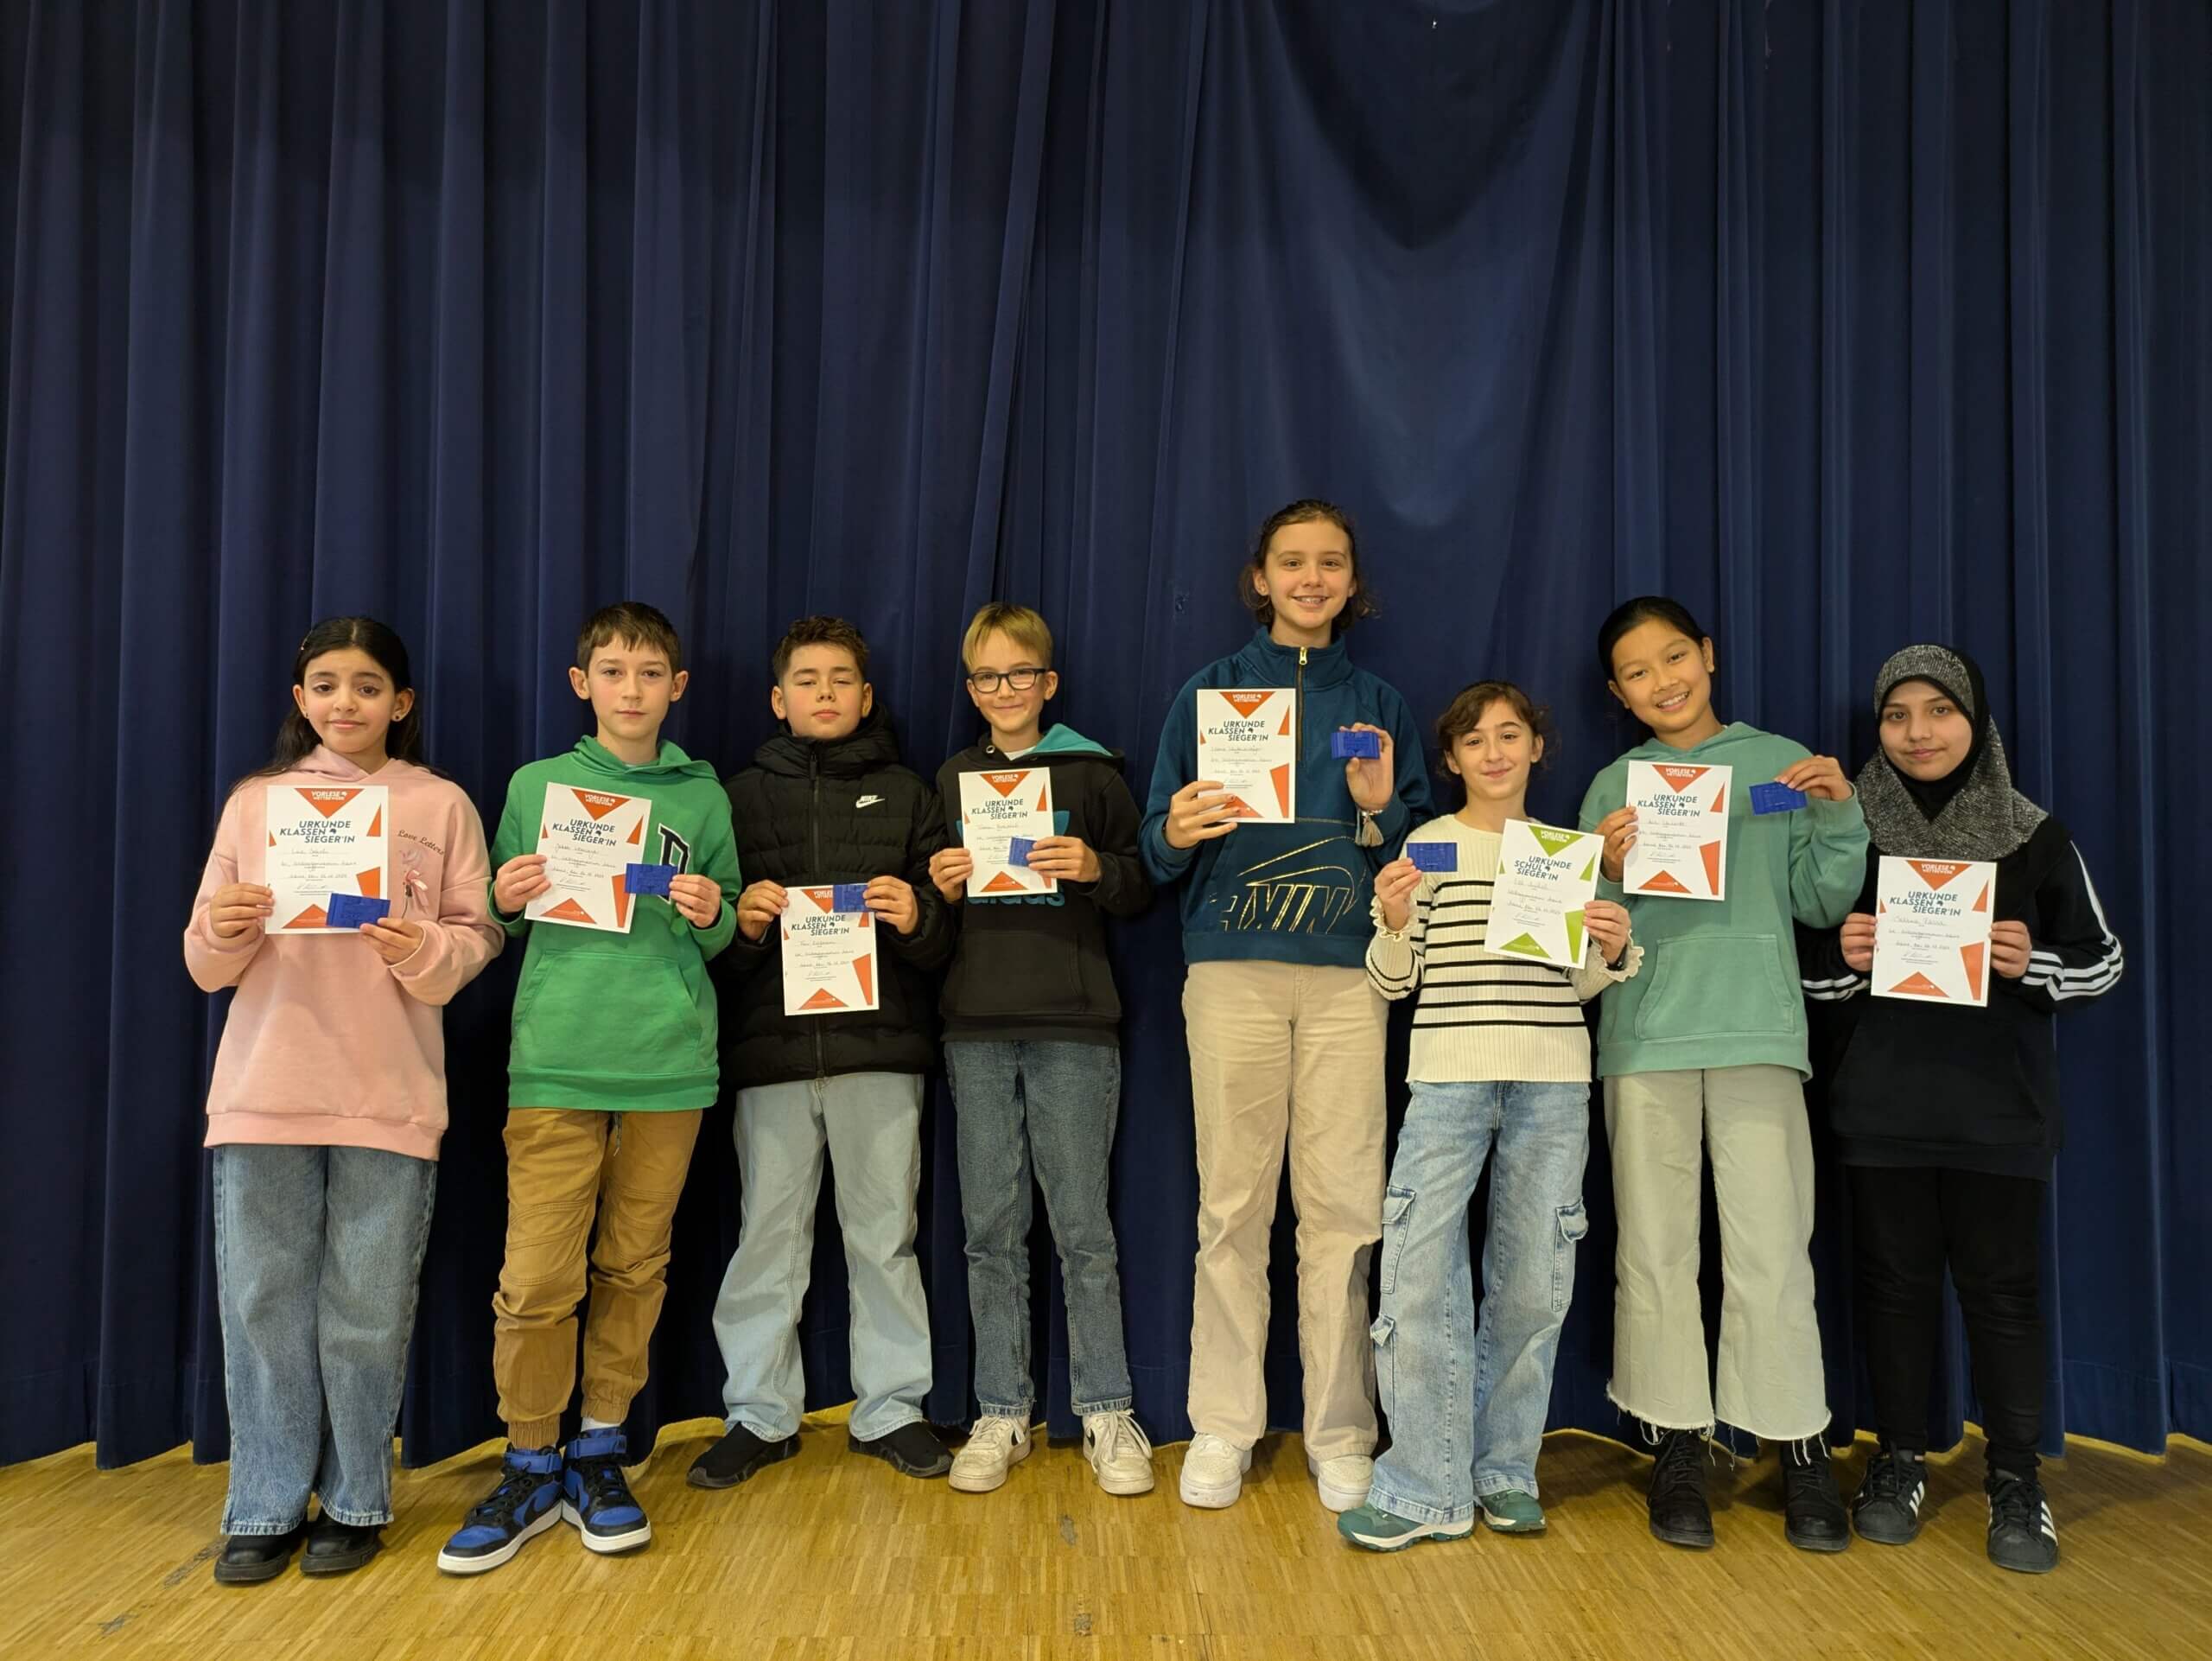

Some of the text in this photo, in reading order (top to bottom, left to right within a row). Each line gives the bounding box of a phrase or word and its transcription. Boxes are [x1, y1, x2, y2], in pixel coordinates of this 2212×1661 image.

[985, 799, 1024, 807] URKUNDE
[1653, 794, 1698, 804] URKUNDE
[971, 805, 1006, 814] KLASSEN
[1637, 800, 1676, 809] KLASSEN
[552, 822, 592, 836] KLASSEN
[569, 818, 615, 833] URKUNDE
[1514, 860, 1542, 872] SCHUL
[1529, 855, 1573, 869] URKUNDE
[1908, 891, 1958, 902] URKUNDE
[1890, 897, 1934, 907] KLASSEN
[805, 914, 846, 923] URKUNDE
[791, 921, 827, 931] KLASSEN
